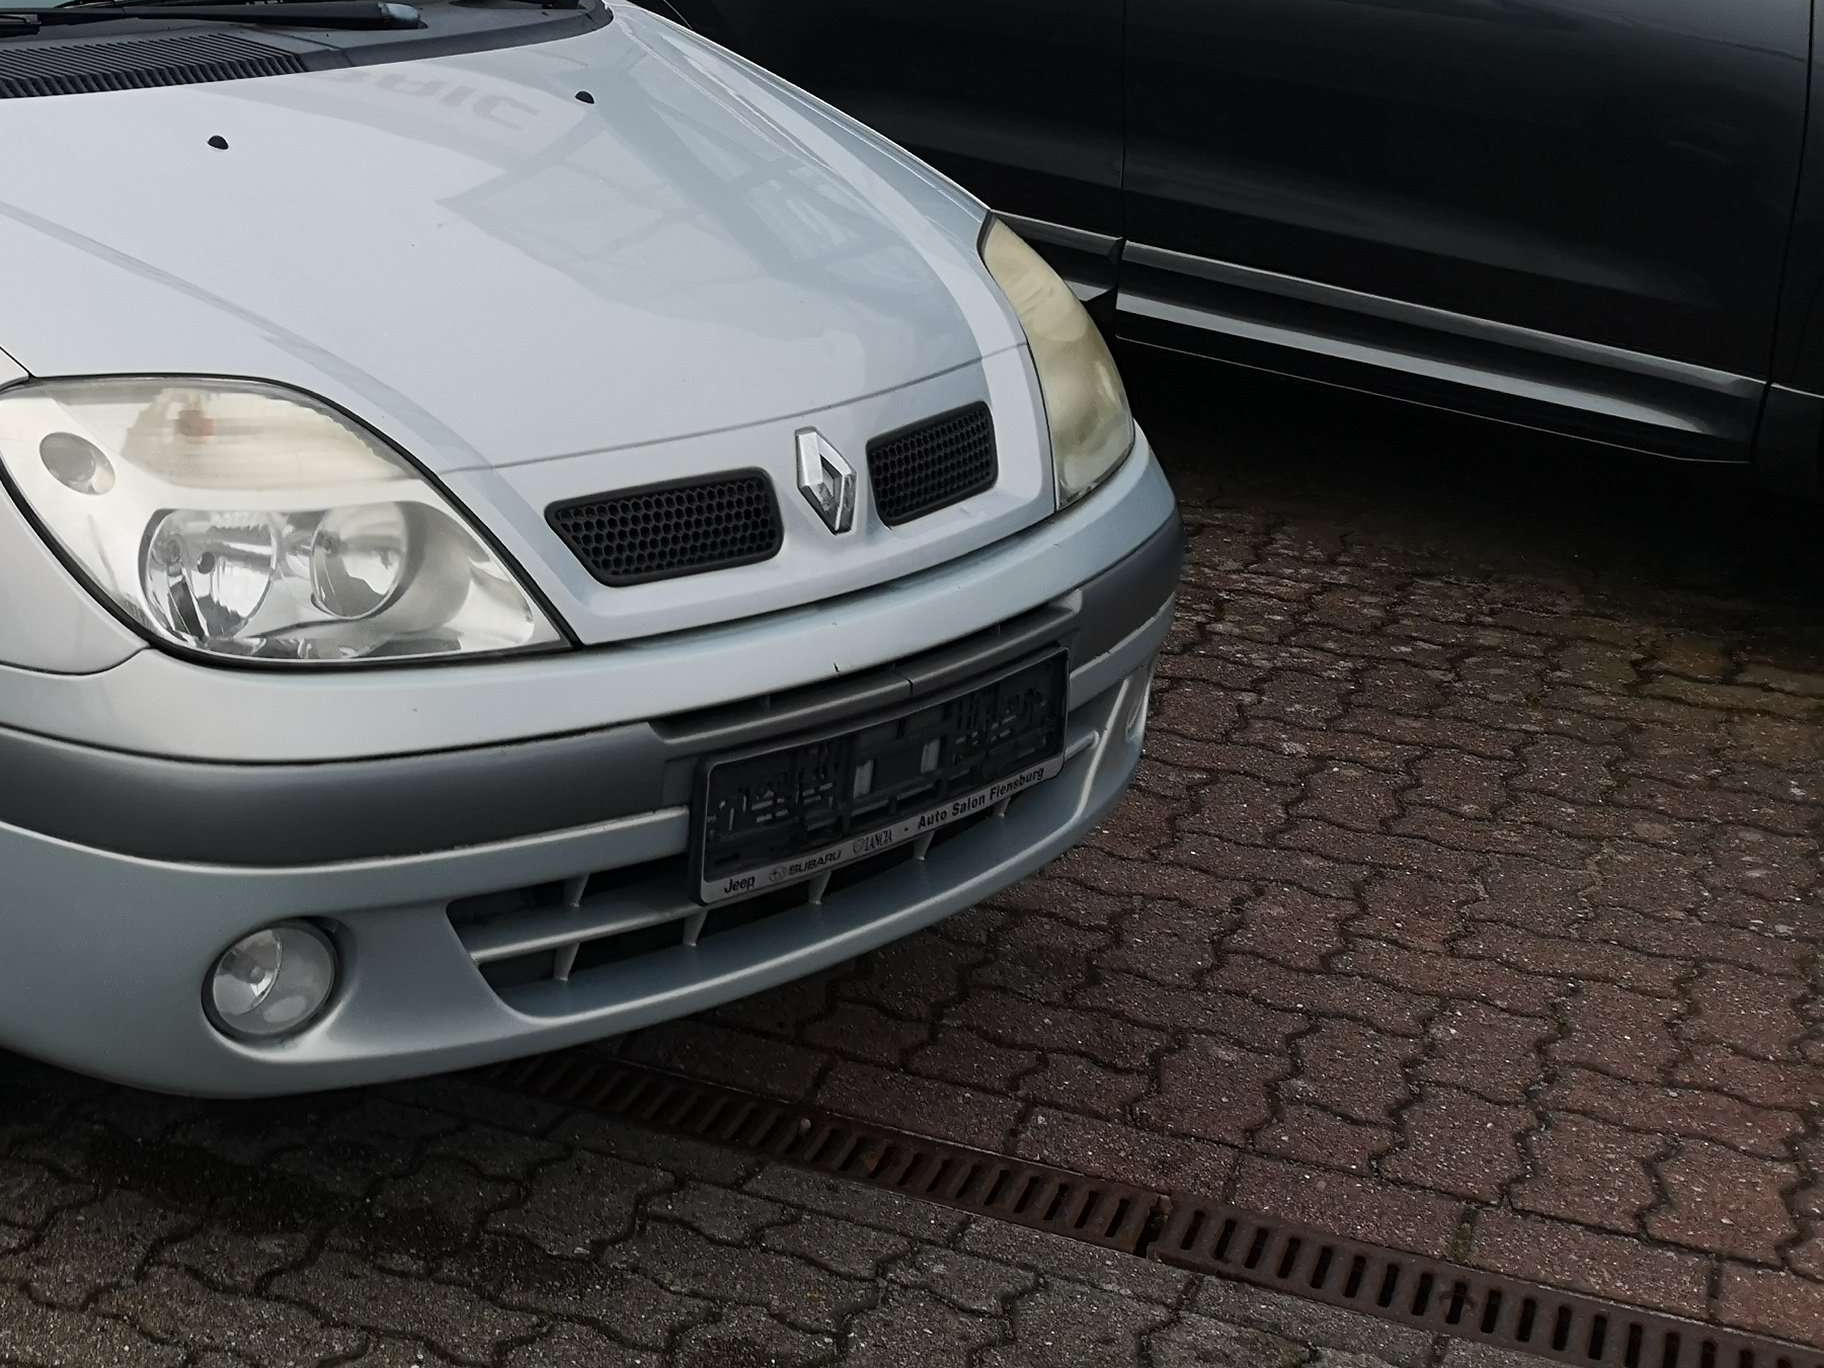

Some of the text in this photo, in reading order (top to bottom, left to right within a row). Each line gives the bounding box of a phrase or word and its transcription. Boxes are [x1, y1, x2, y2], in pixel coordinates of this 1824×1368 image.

[724, 875, 756, 894] Jeep
[787, 849, 842, 876] SUBARU
[918, 808, 948, 830] Auto
[951, 795, 985, 818] Salon
